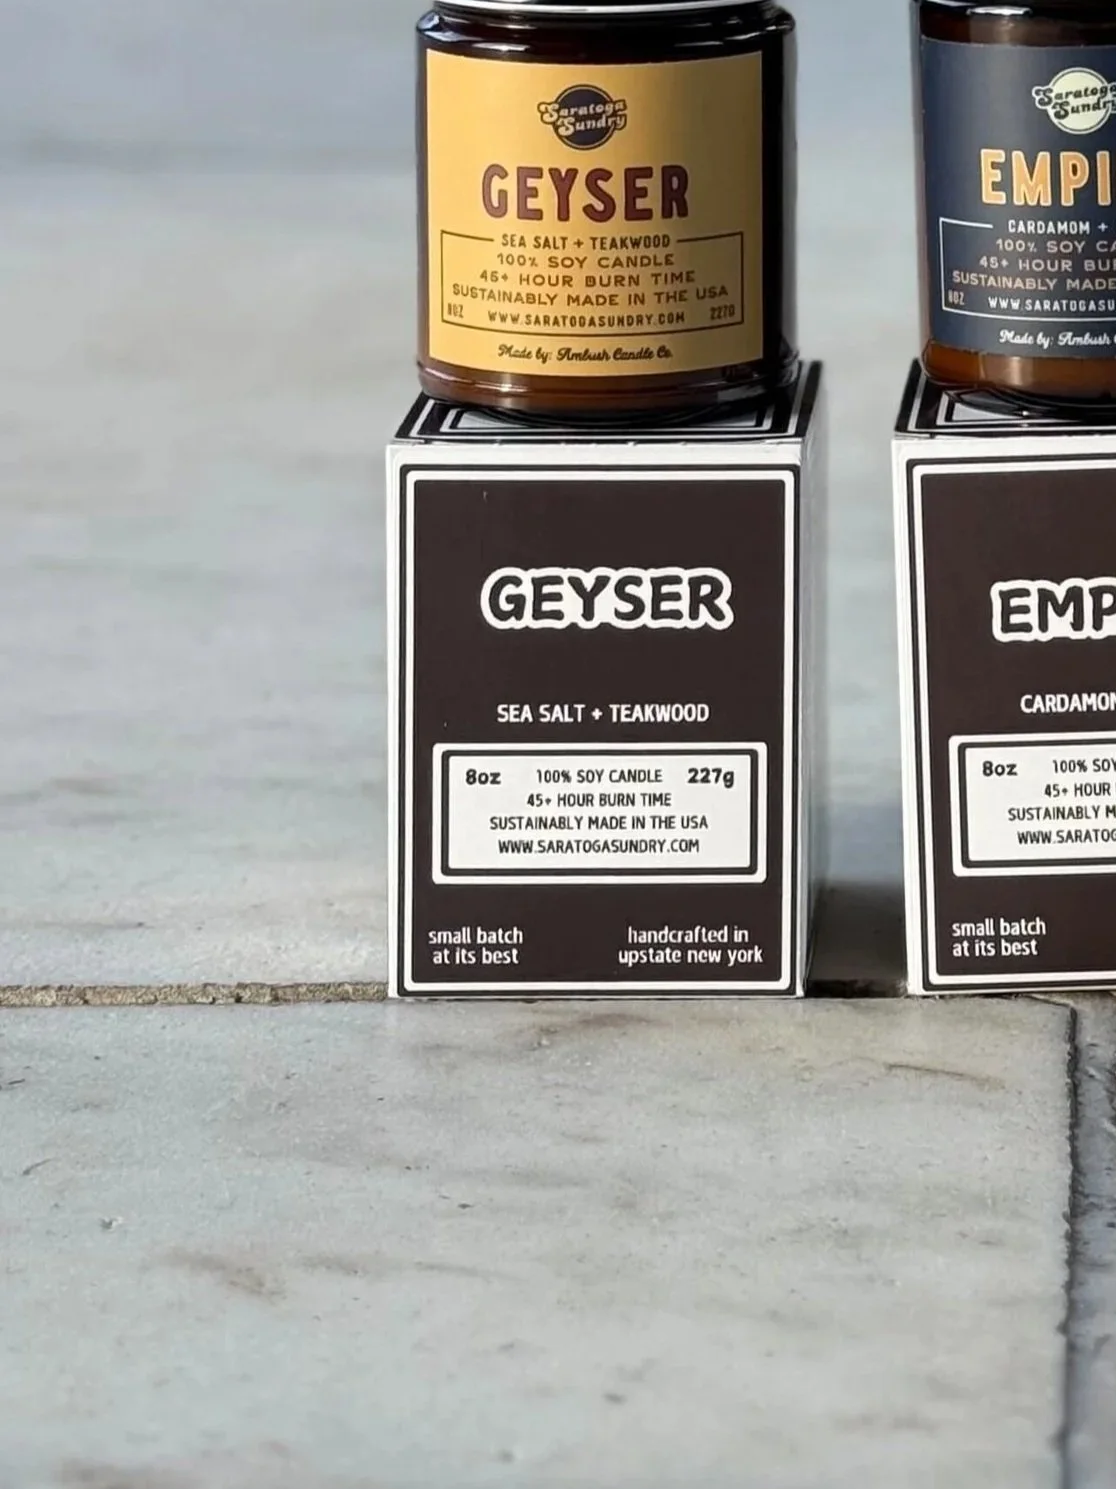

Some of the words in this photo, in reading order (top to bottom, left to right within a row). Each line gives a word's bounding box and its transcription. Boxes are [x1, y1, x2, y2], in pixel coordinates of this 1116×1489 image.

[537, 99, 627, 124] Saratoga
[557, 113, 627, 137] Sundry
[482, 164, 689, 223] GEYSER
[1008, 220, 1090, 234] CARDAMOM
[502, 234, 526, 248] SEA
[533, 235, 568, 250] SALT
[590, 234, 670, 250] TEAKWOOD
[996, 240, 1038, 252] 100%
[1046, 241, 1086, 254] SOY
[497, 254, 538, 267] 100%
[548, 256, 588, 268] SOY
[598, 254, 674, 268] CANDLE
[979, 256, 1008, 268] 45+
[1019, 259, 1072, 272] HOUR
[519, 274, 573, 288] HOUR
[585, 275, 640, 288] BURN
[652, 270, 695, 284] TIME
[952, 270, 1056, 290] SUSTAINABLY
[452, 284, 558, 306] SUSTAINABLY
[567, 294, 618, 306] MADE
[628, 294, 645, 306] IN
[654, 290, 688, 302] THE
[696, 286, 728, 299] USA
[999, 329, 1033, 345] Made
[1058, 332, 1110, 346] Ambush
[498, 344, 532, 360] Made
[613, 347, 654, 361] Candle
[484, 570, 731, 626] GEYSER
[497, 704, 533, 723] SEA
[539, 704, 585, 723] SALT
[609, 704, 709, 723] TEAKWOOD
[982, 761, 1017, 776] 8oz
[1053, 760, 1087, 773] 100%
[466, 769, 501, 785] 8oz
[536, 769, 571, 783] 100%
[577, 769, 603, 783] SOY
[609, 769, 662, 783] CANDLE
[687, 768, 734, 788] 227g
[1045, 784, 1069, 797] 45+
[1074, 782, 1111, 796] HOUR
[527, 794, 551, 807] 45+
[557, 794, 594, 806] HOUR
[599, 794, 635, 806] BURN
[641, 793, 671, 806] TIME
[1008, 806, 1100, 821] SUSTAINABLY
[490, 817, 583, 830] SUSTAINABLY
[588, 817, 627, 829] MADE
[632, 817, 645, 829] IN
[650, 816, 675, 829] THE
[681, 816, 708, 829] USA
[498, 839, 699, 853] WWW.SARATOGASUNDRY.COM
[628, 926, 727, 943] handcrafted
[734, 926, 748, 942] in
[952, 918, 995, 936] small
[1000, 917, 1046, 935] batch
[428, 928, 471, 944] small
[477, 927, 523, 944] batch
[433, 949, 450, 963] at
[456, 947, 476, 963] its
[482, 947, 518, 963] best
[952, 940, 969, 956] at
[975, 939, 995, 956] its
[1001, 939, 1038, 956] best
[619, 947, 681, 967] upstate
[687, 950, 723, 963] new
[728, 946, 763, 966] york
